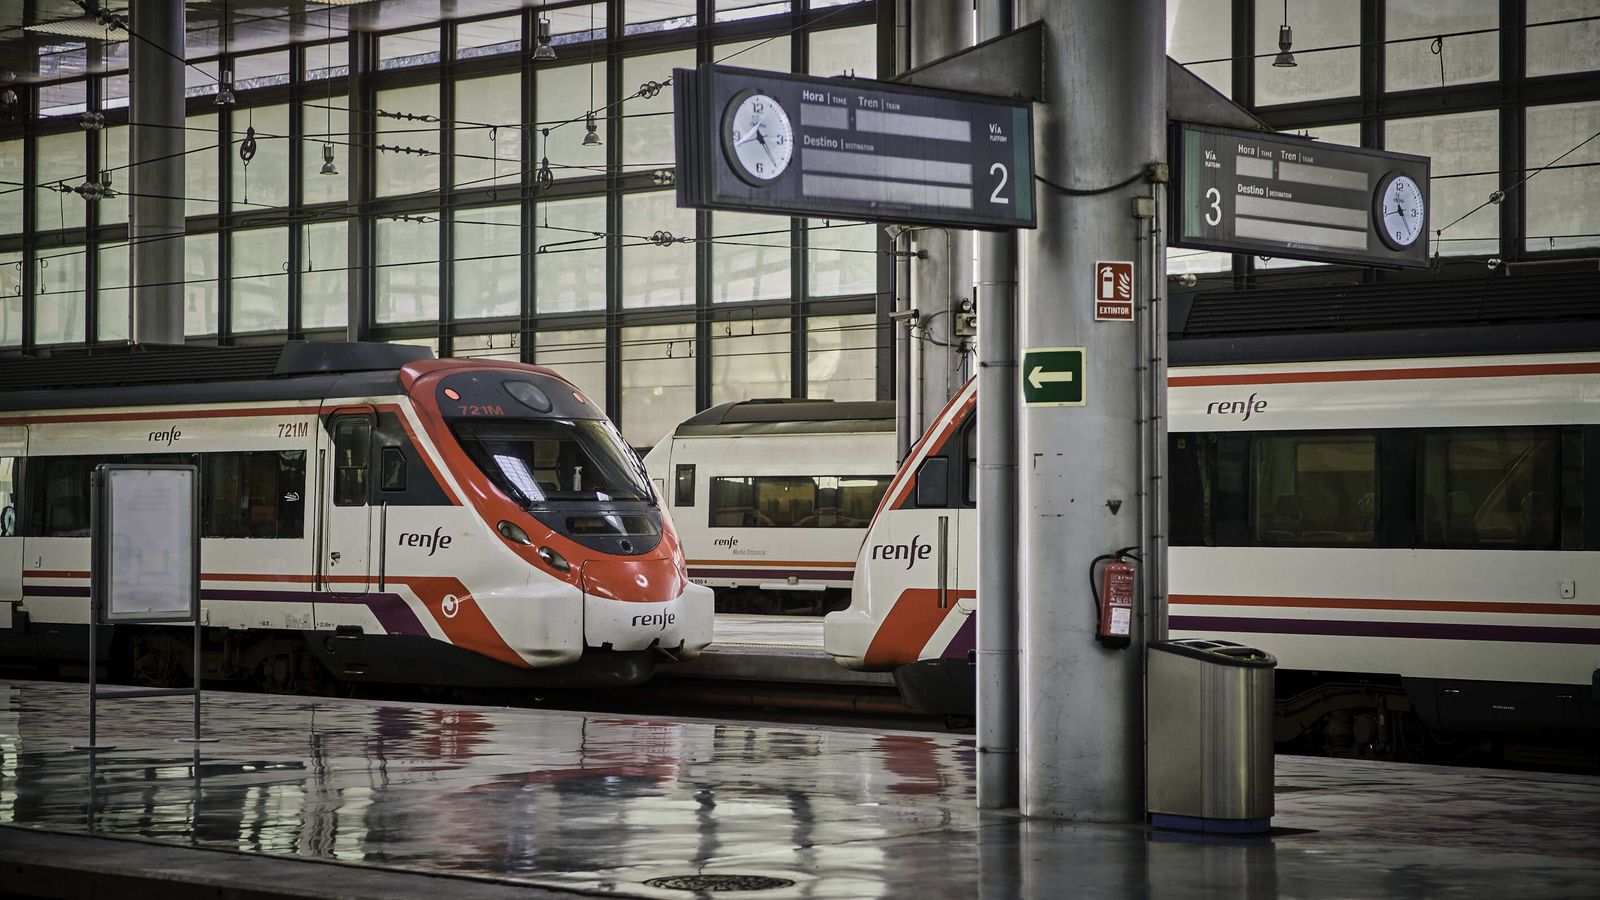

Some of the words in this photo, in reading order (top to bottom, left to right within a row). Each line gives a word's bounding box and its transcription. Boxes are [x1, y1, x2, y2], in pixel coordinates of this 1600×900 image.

[802, 89, 824, 102] Hora
[832, 96, 847, 105] TIME
[858, 96, 879, 108] Tren
[885, 102, 900, 110] TRAIN
[752, 102, 764, 113] 12
[776, 134, 784, 145] 3
[803, 135, 838, 148] Destino
[845, 142, 874, 151] DESTINATION
[1238, 144, 1255, 155] Hora
[1261, 150, 1273, 158] TIME
[1281, 150, 1297, 161] Tren
[756, 162, 763, 173] 6
[989, 162, 1009, 204] 2
[1395, 183, 1404, 191] 12
[1237, 183, 1264, 196] Destino
[1269, 190, 1292, 199] DESTINATION
[1205, 187, 1222, 227] 3
[1411, 208, 1417, 218] 3
[1396, 231, 1402, 241] 6
[1099, 306, 1130, 315] EXTINTOR
[457, 405, 504, 416] 721M
[1207, 392, 1268, 422] renfe
[148, 425, 182, 447] renfe
[278, 422, 309, 438] 721M
[398, 526, 453, 557] renfe
[714, 535, 739, 550] renfe
[872, 534, 932, 570] renfe
[631, 606, 676, 631] renfe
